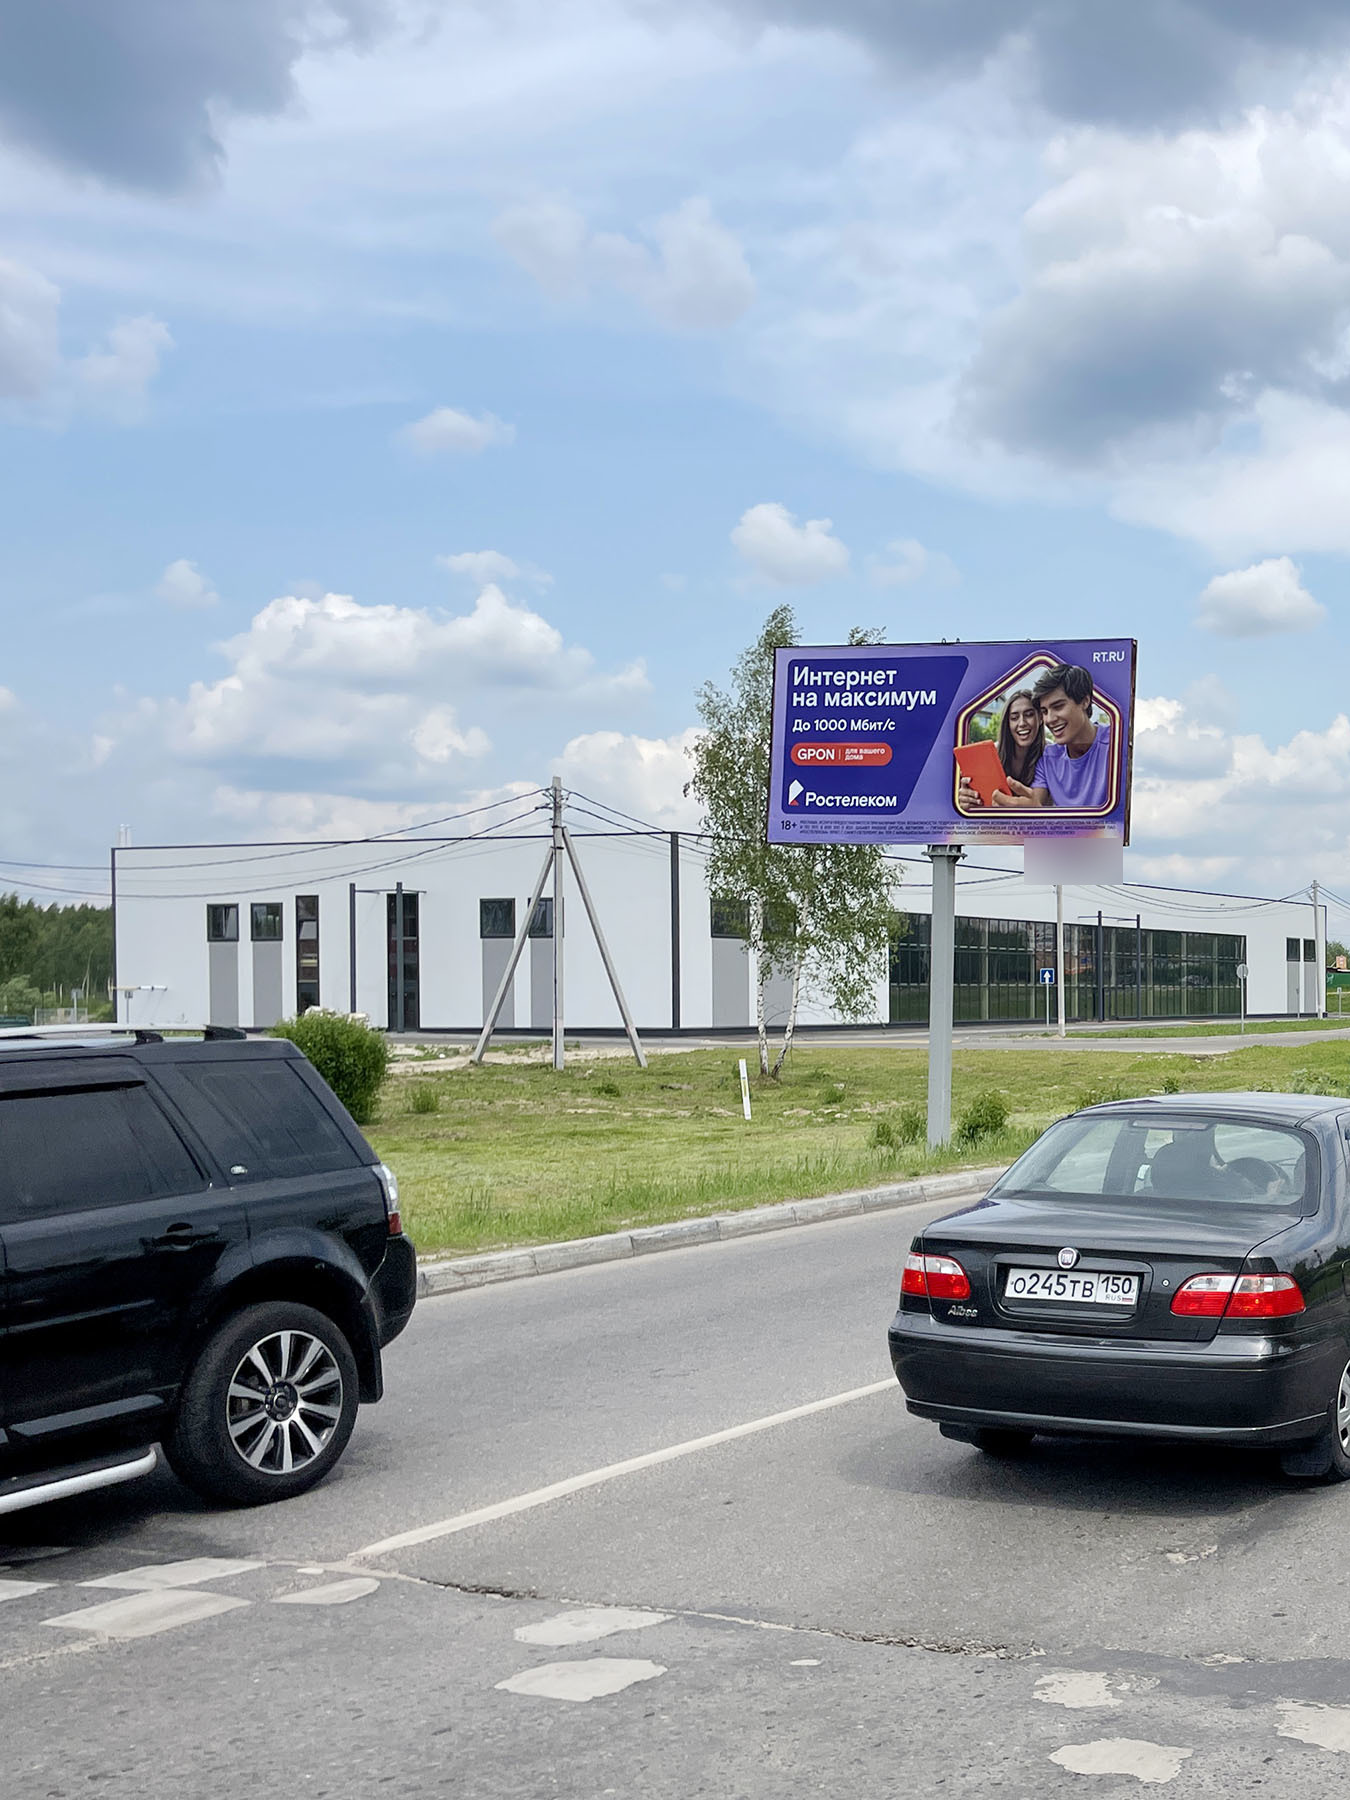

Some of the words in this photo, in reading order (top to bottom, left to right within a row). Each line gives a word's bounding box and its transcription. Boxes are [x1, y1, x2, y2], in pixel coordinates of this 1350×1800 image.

[1092, 650, 1125, 663] RT.RU
[793, 666, 897, 691] Интернет
[792, 691, 818, 707] на
[824, 690, 937, 711] максимум
[792, 719, 811, 733] До
[814, 719, 847, 731] 1000
[850, 718, 896, 732] Мбит/с
[797, 748, 835, 761] GPON
[805, 791, 897, 807] Ростелеком
[780, 820, 798, 831] 18+
[1101, 1276, 1133, 1295] 150
